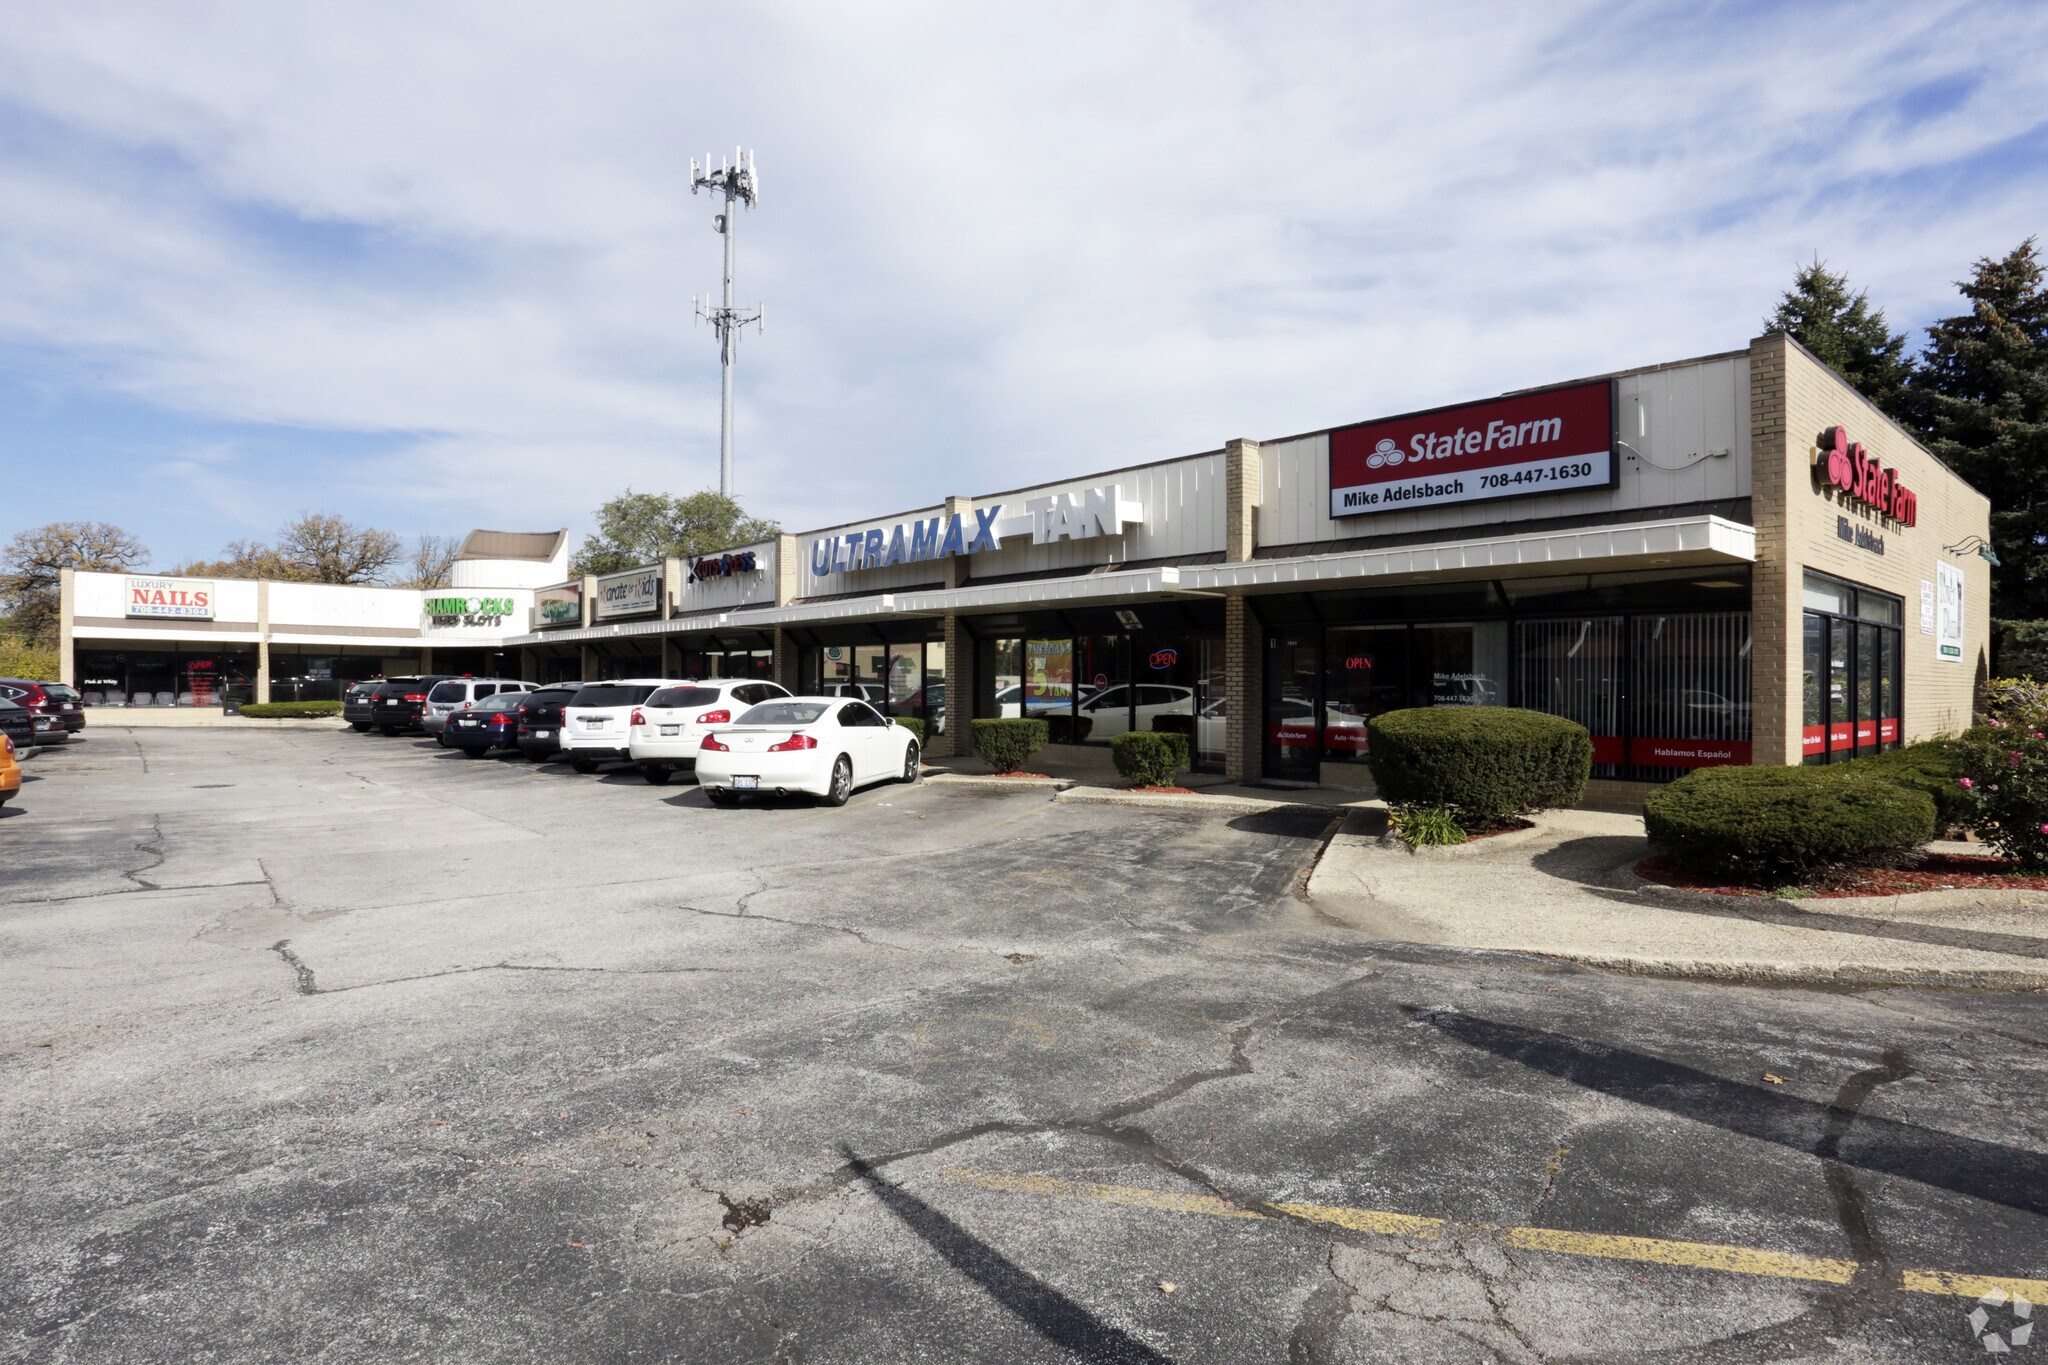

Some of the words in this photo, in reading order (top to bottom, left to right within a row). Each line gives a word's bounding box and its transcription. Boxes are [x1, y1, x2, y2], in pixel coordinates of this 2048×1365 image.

[1344, 490, 1379, 508] Mike
[1383, 479, 1464, 502] Adelsbach
[1480, 462, 1592, 490] 708-447-1630
[811, 504, 1004, 577] ULTRAMAX
[1026, 484, 1123, 545] TAN
[131, 580, 174, 589] LUXURY
[600, 582, 628, 604] Karate
[634, 574, 655, 599] Kids
[132, 588, 209, 607] NAILS
[133, 605, 206, 615] 708-442-8304
[463, 614, 502, 627] SLOTS
[1149, 653, 1177, 666] OPEN
[1345, 657, 1372, 670] OPEN
[1433, 672, 1450, 680] Mike
[1654, 748, 1695, 757] Hablamos
[1697, 749, 1732, 759] Español
